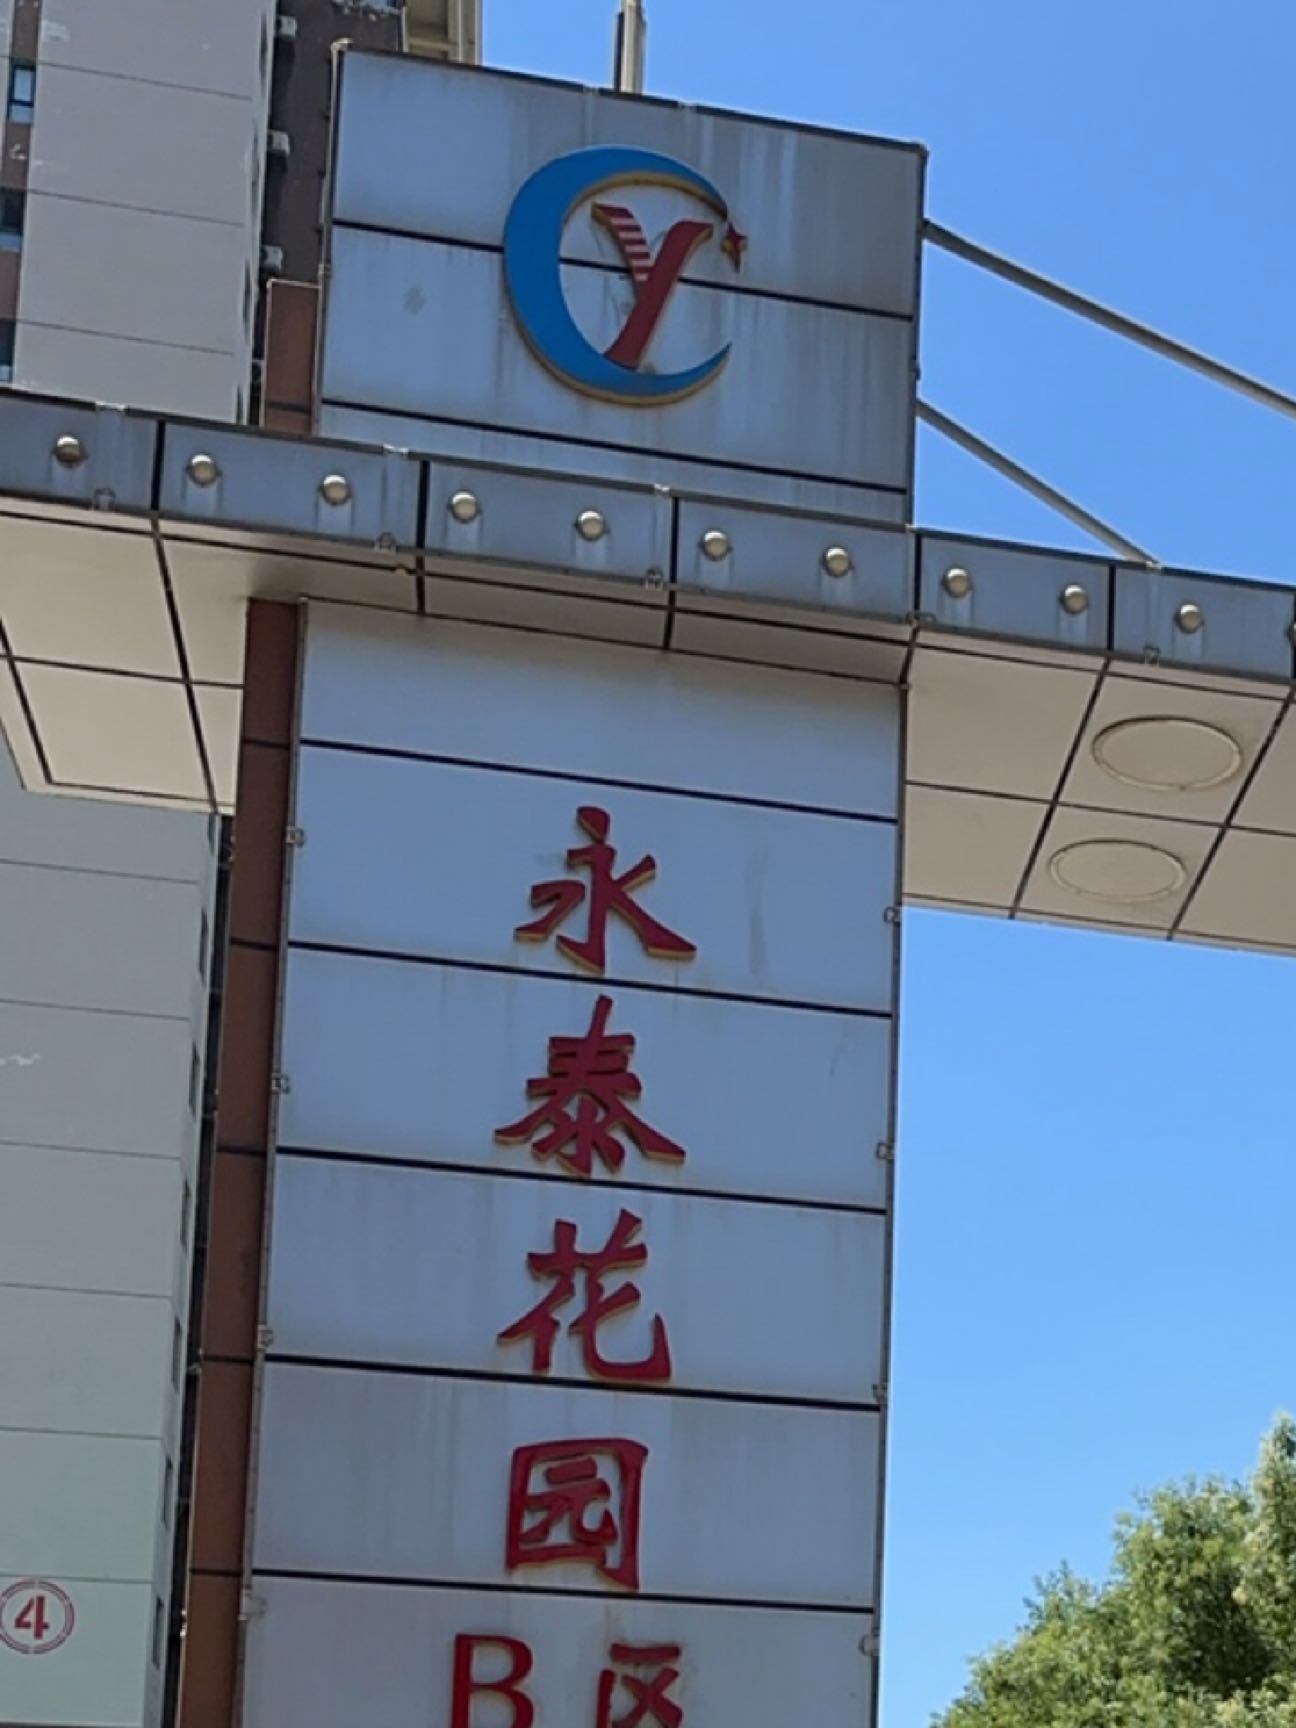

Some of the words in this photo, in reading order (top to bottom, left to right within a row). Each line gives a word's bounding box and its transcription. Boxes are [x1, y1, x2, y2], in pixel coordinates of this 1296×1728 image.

[492, 805, 697, 1592] 永泰花园
[15, 1593, 50, 1641] 4
